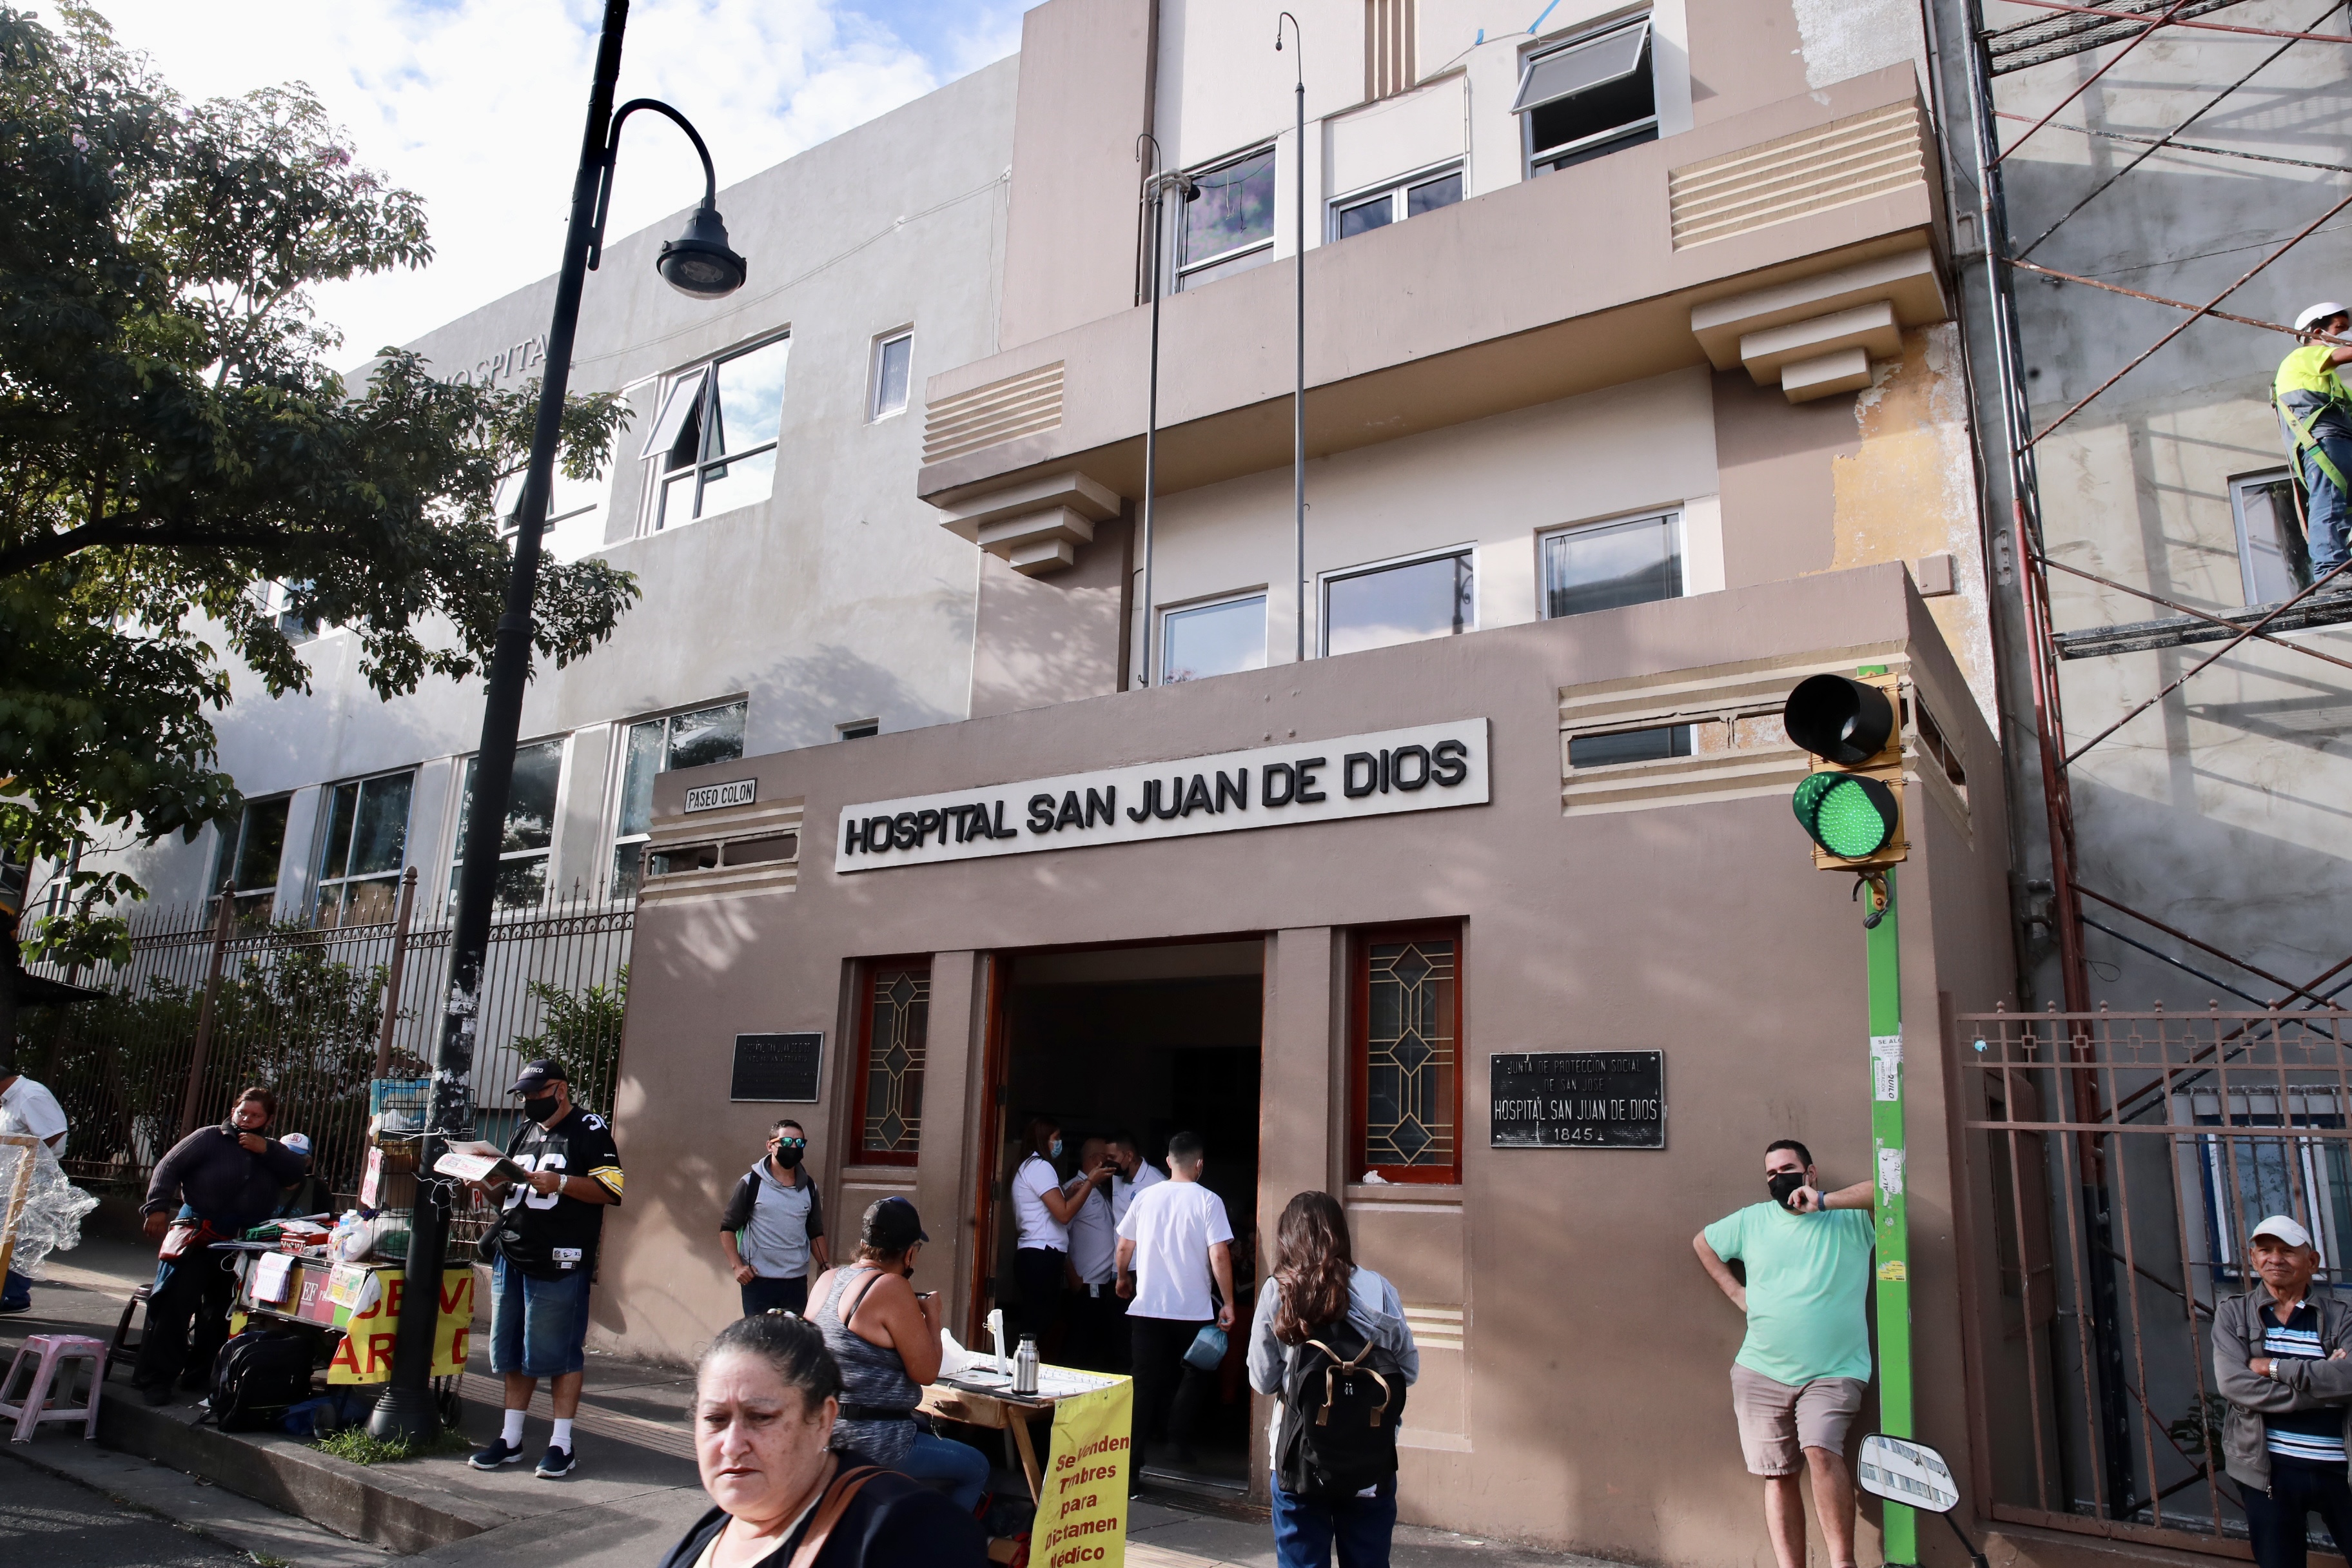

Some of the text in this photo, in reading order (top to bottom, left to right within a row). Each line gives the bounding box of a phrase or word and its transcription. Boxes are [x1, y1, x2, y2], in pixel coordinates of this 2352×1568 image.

[437, 333, 548, 387] OSPITA
[688, 783, 753, 808] PASEO COLON
[845, 739, 1467, 855] HOSPITAL SAN JUAN DE DIOS
[1507, 1059, 1642, 1074] JUNTA DE PROTECCION SOCIAL
[1544, 1078, 1604, 1092] DE SAN JOSE
[1494, 1099, 1657, 1121] HOSPITAL SAN JUAN DE DIOS
[1554, 1128, 1592, 1141] 1845
[301, 1281, 318, 1302] EF
[1055, 1435, 1130, 1473] Se Venden
[1060, 1494, 1097, 1520] para
[1044, 1517, 1117, 1552] Dictamen
